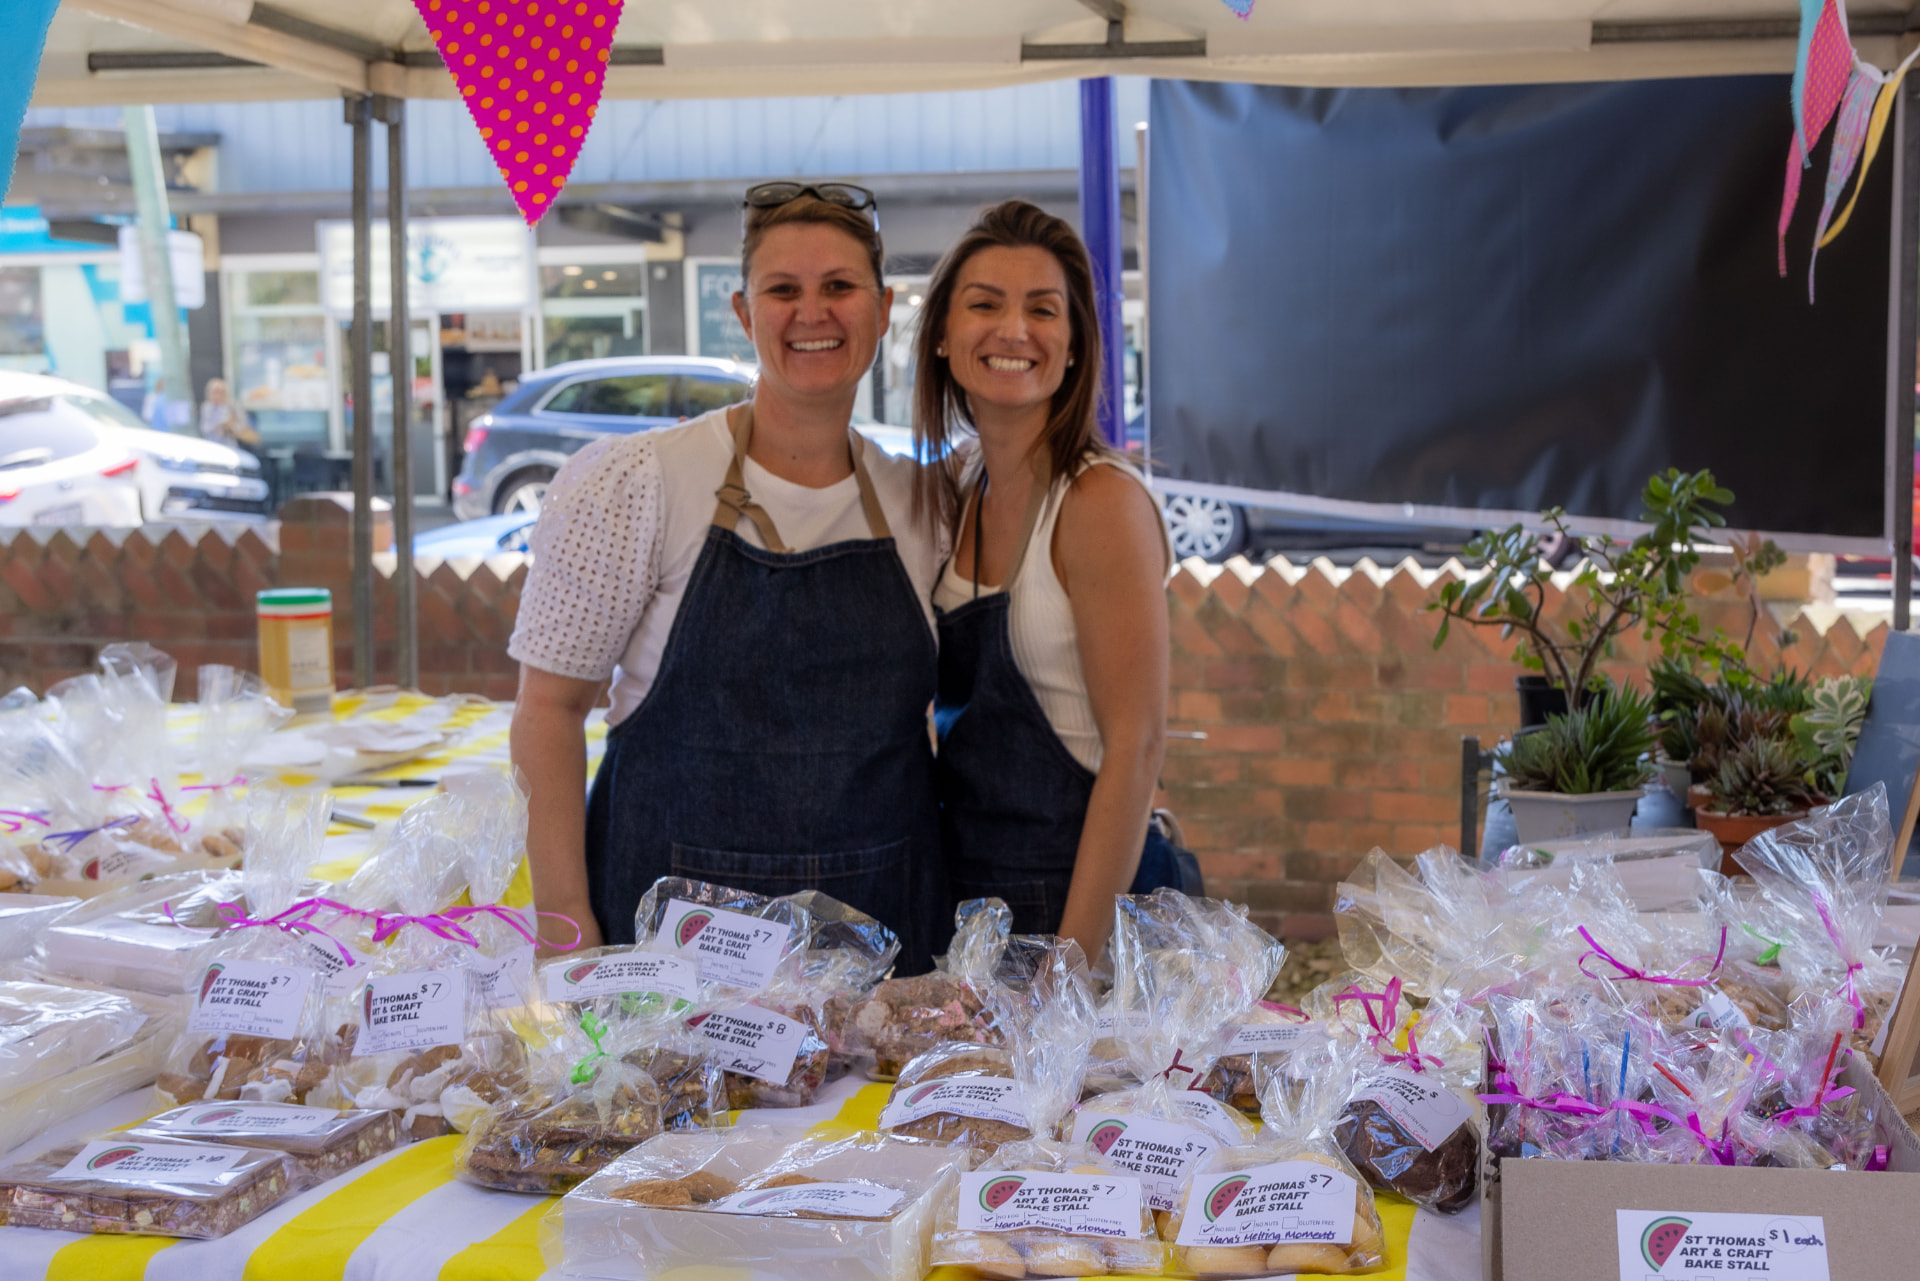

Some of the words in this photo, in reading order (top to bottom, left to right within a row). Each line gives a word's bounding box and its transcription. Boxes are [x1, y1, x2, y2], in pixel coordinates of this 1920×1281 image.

[705, 925, 716, 934] ST
[718, 928, 751, 941] THOMAS
[699, 934, 717, 943] ART
[726, 940, 752, 951] CRAFT
[309, 943, 345, 966] THOMAS
[699, 943, 722, 954] BAKE
[723, 948, 747, 960] STALL
[596, 972, 624, 980] BAKE
[216, 978, 228, 986] ST
[229, 978, 268, 989] THOMAS
[237, 989, 269, 999] CRAFT
[380, 992, 418, 1004] THOMAS
[210, 996, 231, 1005] BAKE
[234, 998, 262, 1007] STALL
[382, 1006, 388, 1014] &
[390, 1002, 423, 1013] CRAFT
[390, 1011, 420, 1022] STALL
[710, 1014, 723, 1022] ST
[725, 1017, 763, 1031] THOMAS
[703, 1022, 723, 1031] ART
[733, 1028, 764, 1040] CRAFT
[704, 1030, 727, 1041] BAKE
[729, 1036, 757, 1048] STALL
[956, 1084, 1000, 1092] THOMAS
[1386, 1076, 1426, 1094] THOMAS
[1393, 1083, 1425, 1101] CRAFT
[965, 1094, 999, 1103] STALL
[1387, 1086, 1414, 1105] STALL
[1117, 1138, 1132, 1147] ST
[1134, 1140, 1182, 1156] THOMAS
[147, 1156, 192, 1164] THOMAS
[1111, 1149, 1133, 1159] ART
[1136, 1152, 1143, 1160] &
[1146, 1154, 1185, 1167] CRAFT
[1144, 1165, 1178, 1178] STALL
[1037, 1187, 1088, 1195] THOMAS
[1241, 1187, 1256, 1196] ST
[1258, 1181, 1305, 1194] THOMAS
[1149, 1195, 1174, 1211] lting
[1234, 1198, 1255, 1207] ART
[1269, 1191, 1309, 1201] CRAFT
[1016, 1204, 1049, 1212] BAKE
[1052, 1203, 1090, 1212] STALL
[1235, 1206, 1265, 1216] BAKE
[1268, 1202, 1304, 1212] STALL
[995, 1220, 1031, 1229] Nana's
[1077, 1225, 1127, 1237] Moments
[1209, 1235, 1240, 1244] Nana's
[1244, 1229, 1281, 1244] Melting
[1285, 1231, 1336, 1240] Moments
[1684, 1236, 1703, 1244] ST
[1707, 1236, 1765, 1247] THOMAS
[1794, 1235, 1824, 1246] each
[1679, 1247, 1708, 1256] ART
[1713, 1249, 1722, 1257] &
[1727, 1249, 1773, 1259] CRAFT
[1684, 1259, 1723, 1269] BAKE
[1727, 1260, 1770, 1271] STALL
